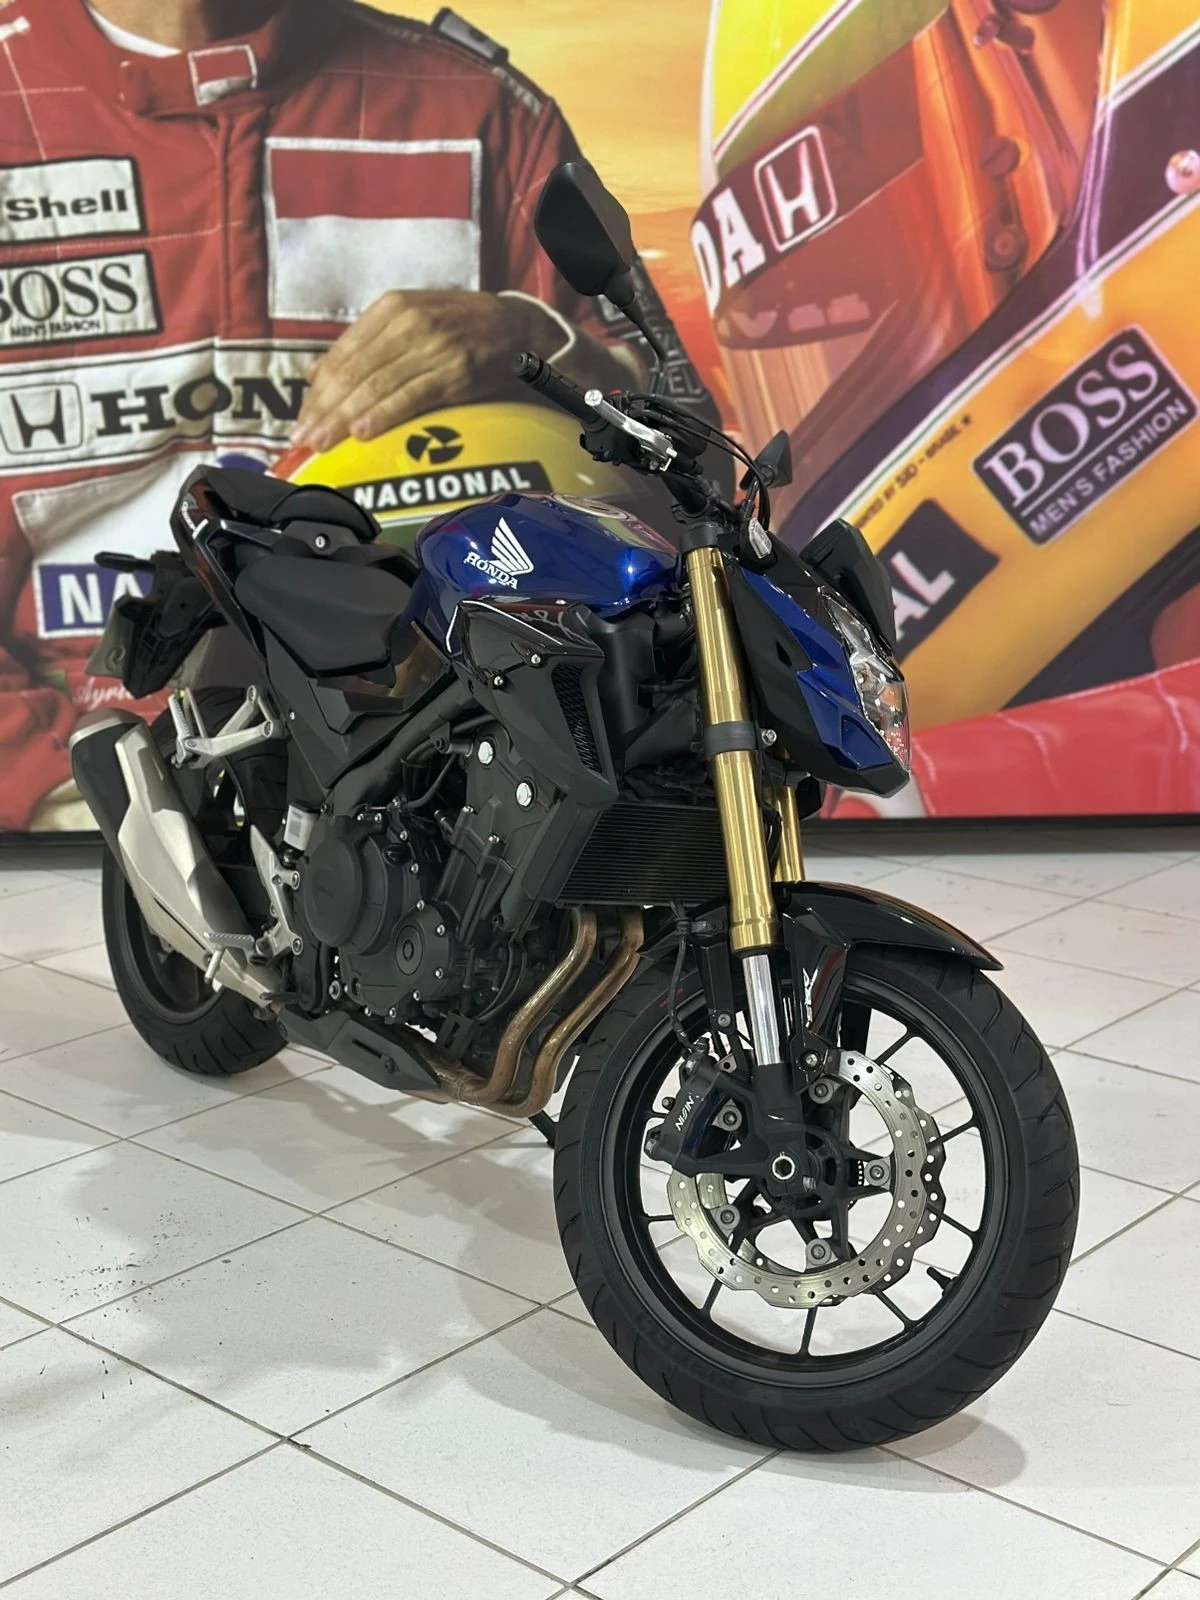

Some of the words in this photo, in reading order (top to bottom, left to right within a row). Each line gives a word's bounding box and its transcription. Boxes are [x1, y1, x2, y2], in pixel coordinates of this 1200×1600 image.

[5, 189, 129, 222] Shell
[691, 186, 766, 318] DA
[982, 343, 1159, 508] BOSS
[1091, 397, 1189, 483] FASHION
[352, 467, 532, 510] NACIONAL
[463, 551, 518, 590] HONDA
